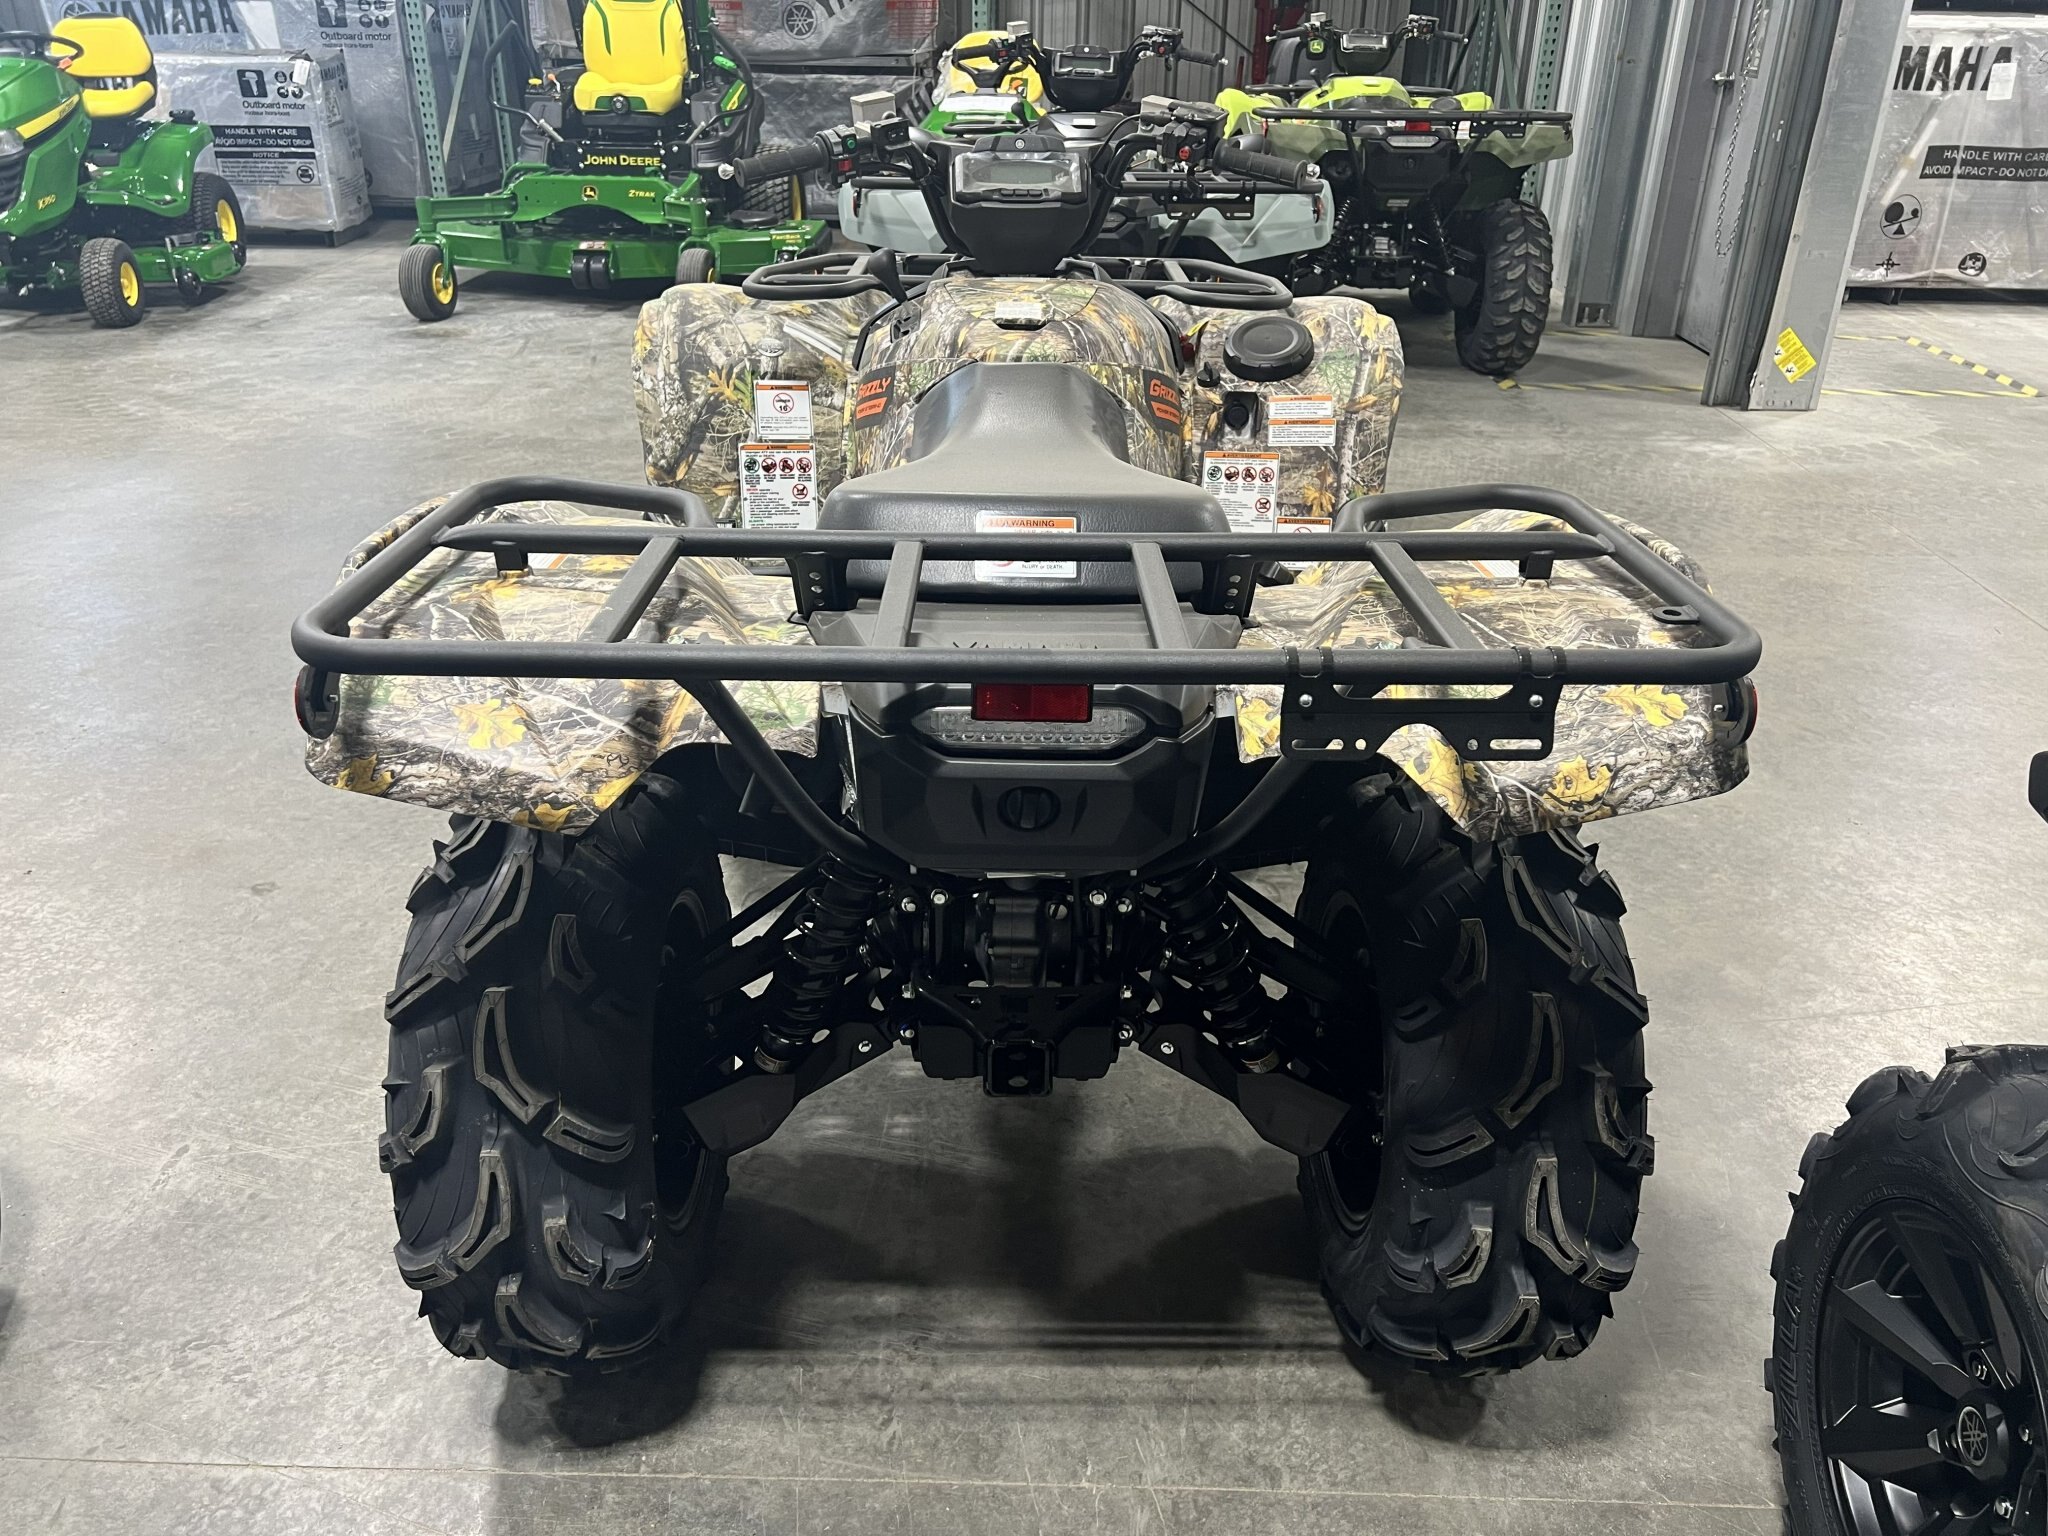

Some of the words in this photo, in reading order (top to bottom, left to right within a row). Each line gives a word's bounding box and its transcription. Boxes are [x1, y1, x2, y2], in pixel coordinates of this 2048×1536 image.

[320, 31, 363, 40] Outboard
[365, 32, 392, 40] motor
[242, 100, 281, 109] Outboard
[282, 102, 306, 110] motor
[276, 128, 298, 136] CARE
[215, 138, 236, 146] AVOID
[584, 154, 617, 165] JOHN
[619, 155, 661, 166] DEERE
[1943, 150, 1990, 160] HANDLE
[1993, 152, 2021, 161] WITH
[1923, 165, 1951, 175] AVOID
[2016, 168, 2038, 177] NOT
[628, 189, 656, 198] ZTRAK
